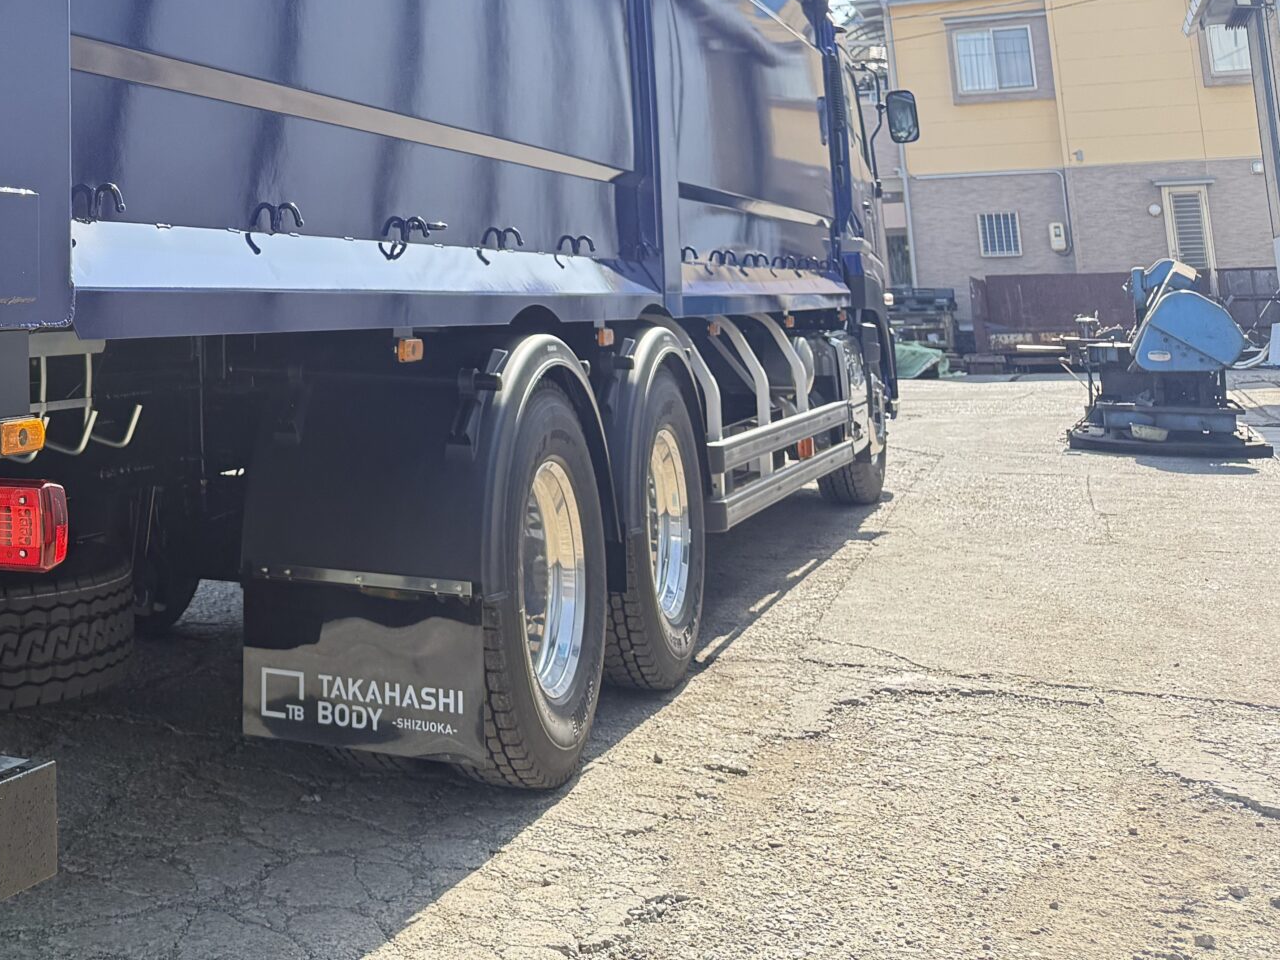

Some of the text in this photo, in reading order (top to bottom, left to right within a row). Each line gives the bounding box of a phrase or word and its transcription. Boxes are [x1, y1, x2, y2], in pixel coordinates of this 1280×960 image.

[318, 674, 464, 715] TAKAHASHI
[286, 704, 305, 721] TB
[317, 701, 458, 735] BODY -SHIZUOKA-
